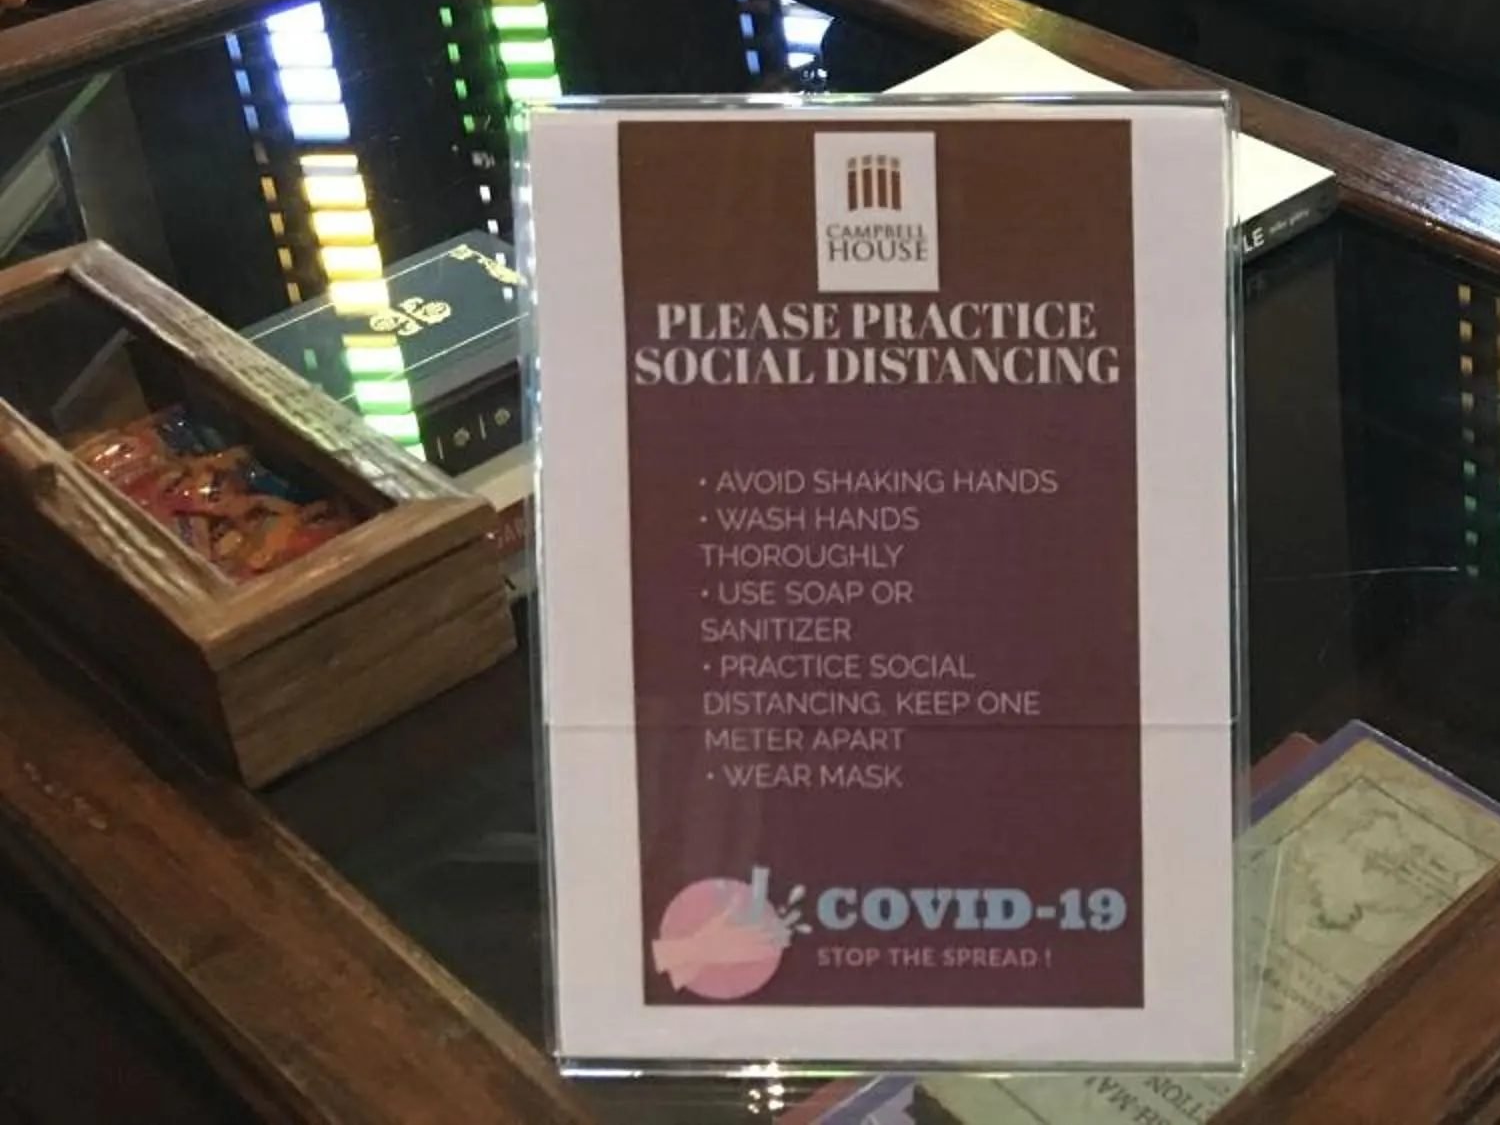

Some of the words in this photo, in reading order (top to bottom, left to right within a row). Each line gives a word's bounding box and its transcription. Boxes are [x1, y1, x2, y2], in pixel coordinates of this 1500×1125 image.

[826, 224, 928, 241] CAMPBELL
[827, 240, 929, 262] HOUSE
[657, 302, 840, 340] PLEASE
[852, 302, 1097, 340] PRACTICE
[635, 347, 814, 385] SOCIAL
[826, 346, 1119, 384] DISTANCING
[715, 469, 806, 495] AVOID
[813, 469, 945, 494] SHAKING
[953, 468, 1058, 494] HANDS
[716, 506, 806, 532] WASH
[815, 506, 920, 532] HANDS
[700, 543, 904, 569] THOROUGHLY
[718, 580, 776, 606] USE
[784, 580, 864, 605] SOAP
[870, 580, 913, 605] OR
[700, 617, 851, 642] SANITIZER
[720, 653, 861, 679] PRACTICE
[869, 653, 976, 679] SOCIAL
[896, 690, 971, 716] KEEP
[977, 690, 1040, 716] ONE
[704, 727, 804, 752] METER
[811, 727, 904, 751] APART
[722, 762, 811, 788] WEAR
[819, 764, 903, 789] MASK
[816, 887, 1127, 931] COVID-19
[817, 946, 881, 967] STOP
[888, 947, 934, 967] THE
